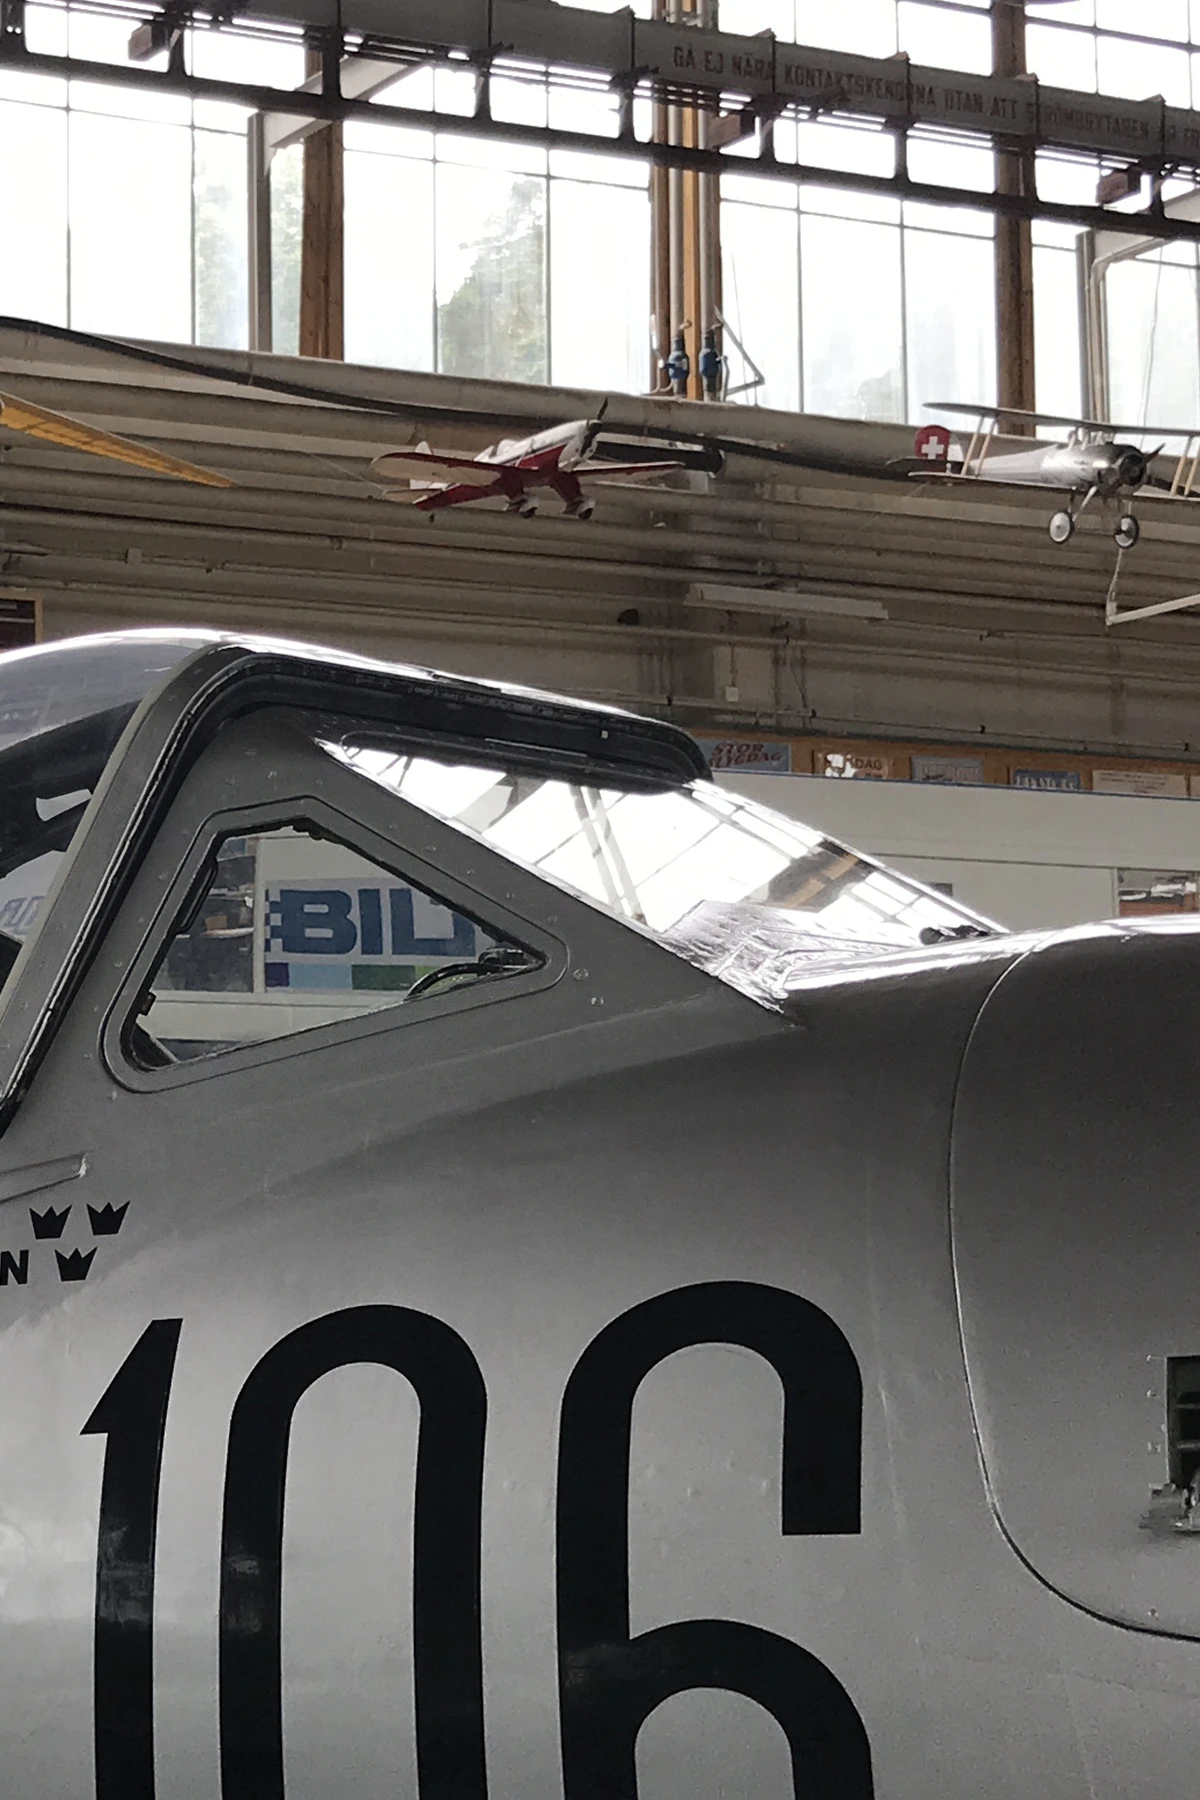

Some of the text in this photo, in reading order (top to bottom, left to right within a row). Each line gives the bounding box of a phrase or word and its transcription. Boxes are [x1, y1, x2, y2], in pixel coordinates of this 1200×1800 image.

[704, 51, 725, 74] EJ
[944, 88, 984, 114] UTAN
[989, 98, 1017, 120] ATT
